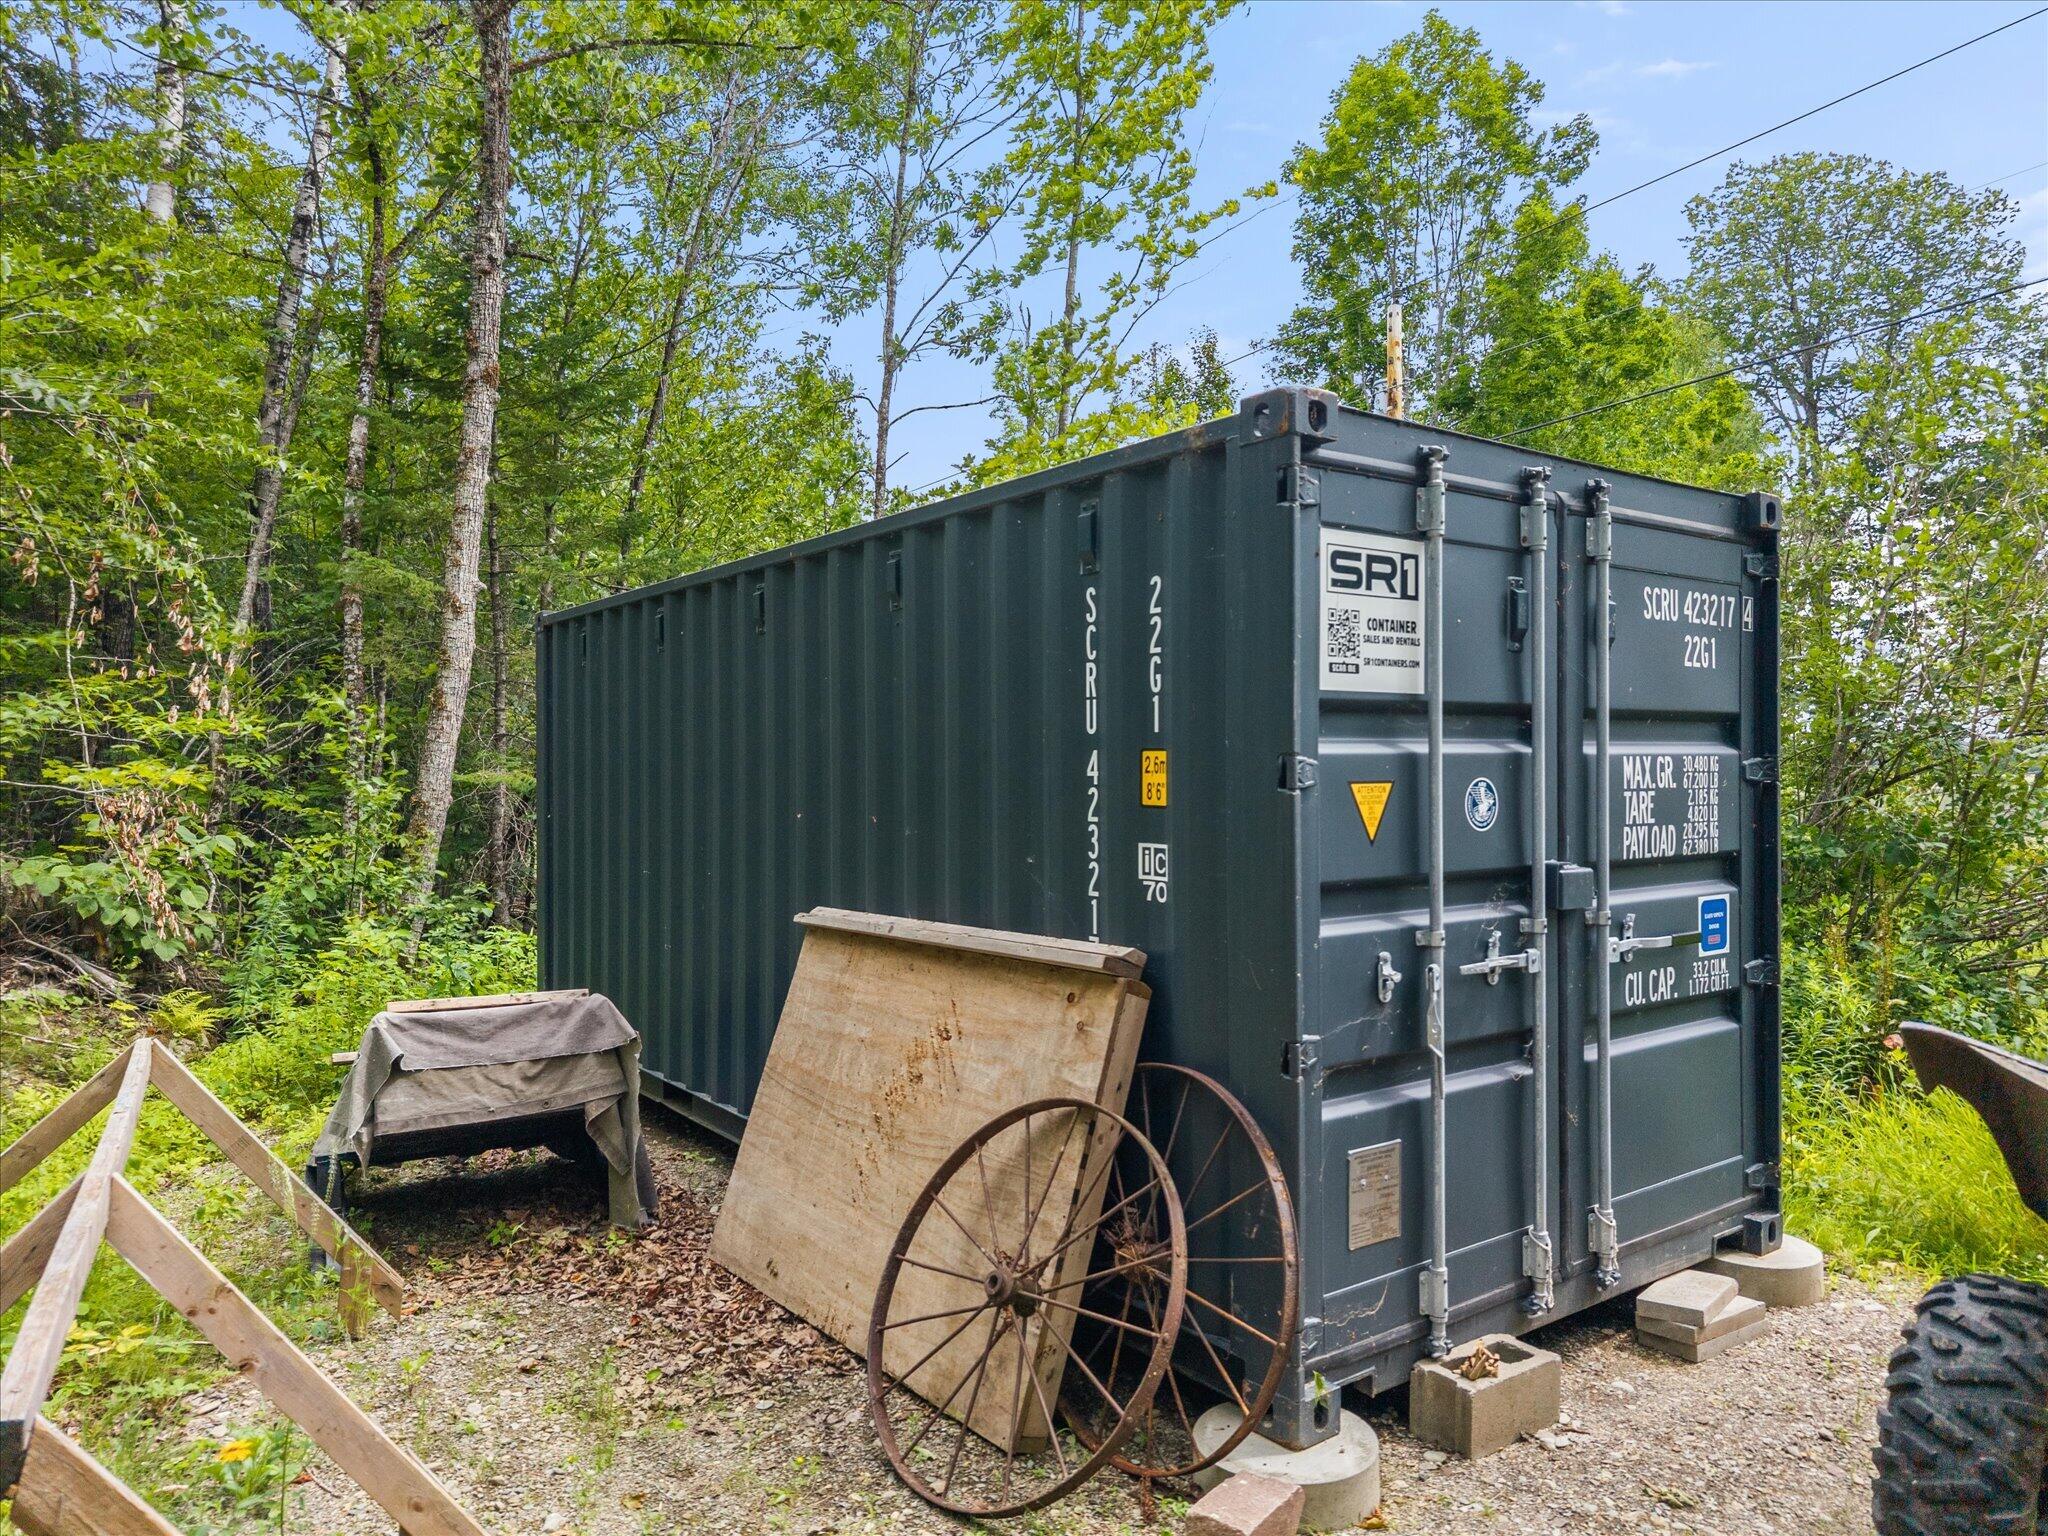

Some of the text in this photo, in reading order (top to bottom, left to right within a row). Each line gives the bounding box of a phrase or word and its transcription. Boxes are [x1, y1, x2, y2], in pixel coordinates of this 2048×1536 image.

[1330, 549, 1417, 598] SR1
[1643, 586, 1753, 631] SCRU 423217 4
[1367, 617, 1417, 634] CONTAINER
[1363, 634, 1420, 647] SALES AND RENTALS
[1149, 575, 1162, 733] 22G1
[1684, 634, 1716, 669] 22G1
[1086, 587, 1099, 943] SCRU 42321
[1682, 755, 1719, 772] 30.480 KG
[1357, 785, 1387, 794] ATTENTION
[1682, 772, 1719, 789] 67.200 LB
[1687, 788, 1719, 806] 2.185 KG
[1623, 790, 1656, 825] TARE
[1687, 805, 1719, 822] 4.820 LB
[1682, 821, 1719, 840] 28.295 KG
[1623, 824, 1677, 860] PAYLOAD
[1682, 838, 1719, 856] 62.380 LB
[1142, 881, 1168, 903] 70
[1692, 960, 1709, 979] 33.2
[1625, 966, 1679, 1007] CU. CAP.
[1689, 977, 1709, 997] 1.172
